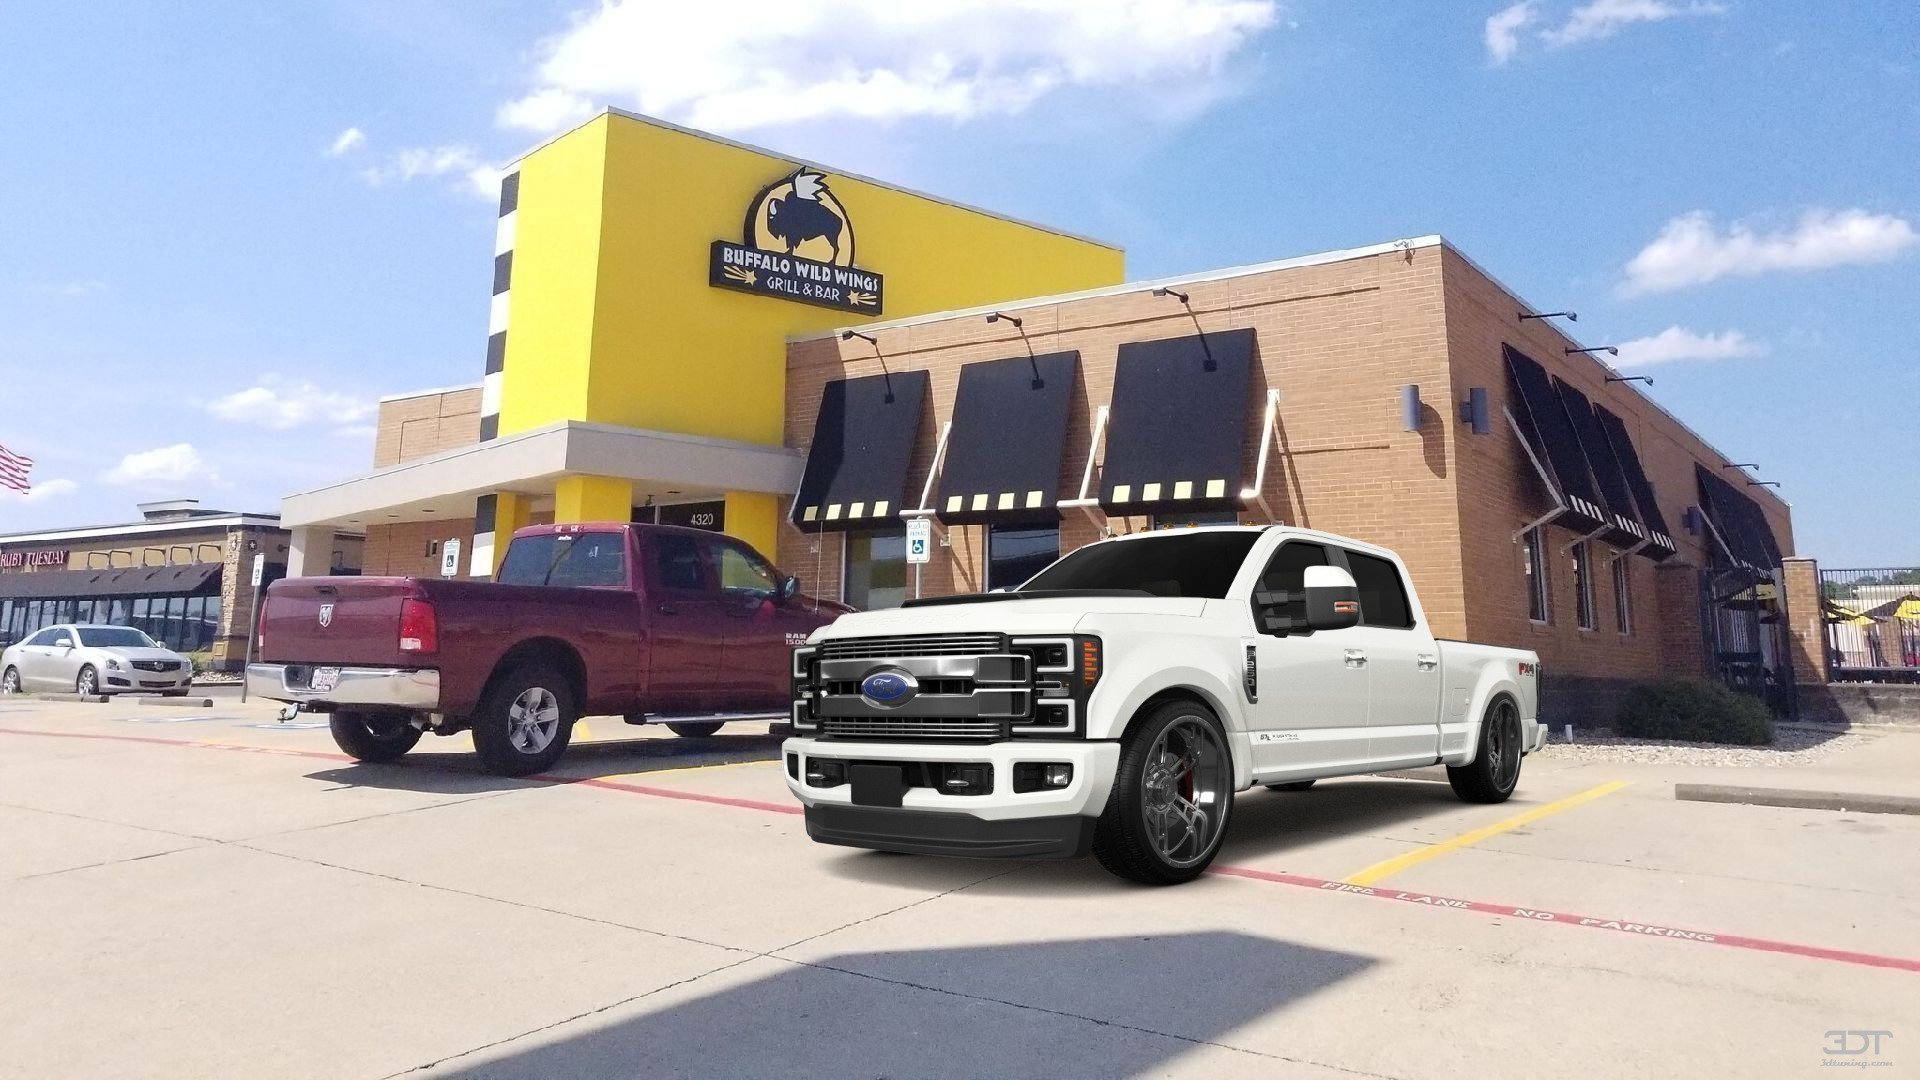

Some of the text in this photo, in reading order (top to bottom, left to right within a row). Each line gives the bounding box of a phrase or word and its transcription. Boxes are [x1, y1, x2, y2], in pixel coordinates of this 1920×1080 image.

[723, 247, 878, 292] BUFFALO WILD WINGS
[766, 276, 840, 301] GRILL & BAR
[690, 513, 714, 526] 4320
[0, 550, 67, 567] RUBY TUESDAY
[1518, 662, 1535, 676] FX4
[872, 678, 899, 696] Ford
[1319, 881, 1716, 943] FIRE LANE NO PARKING
